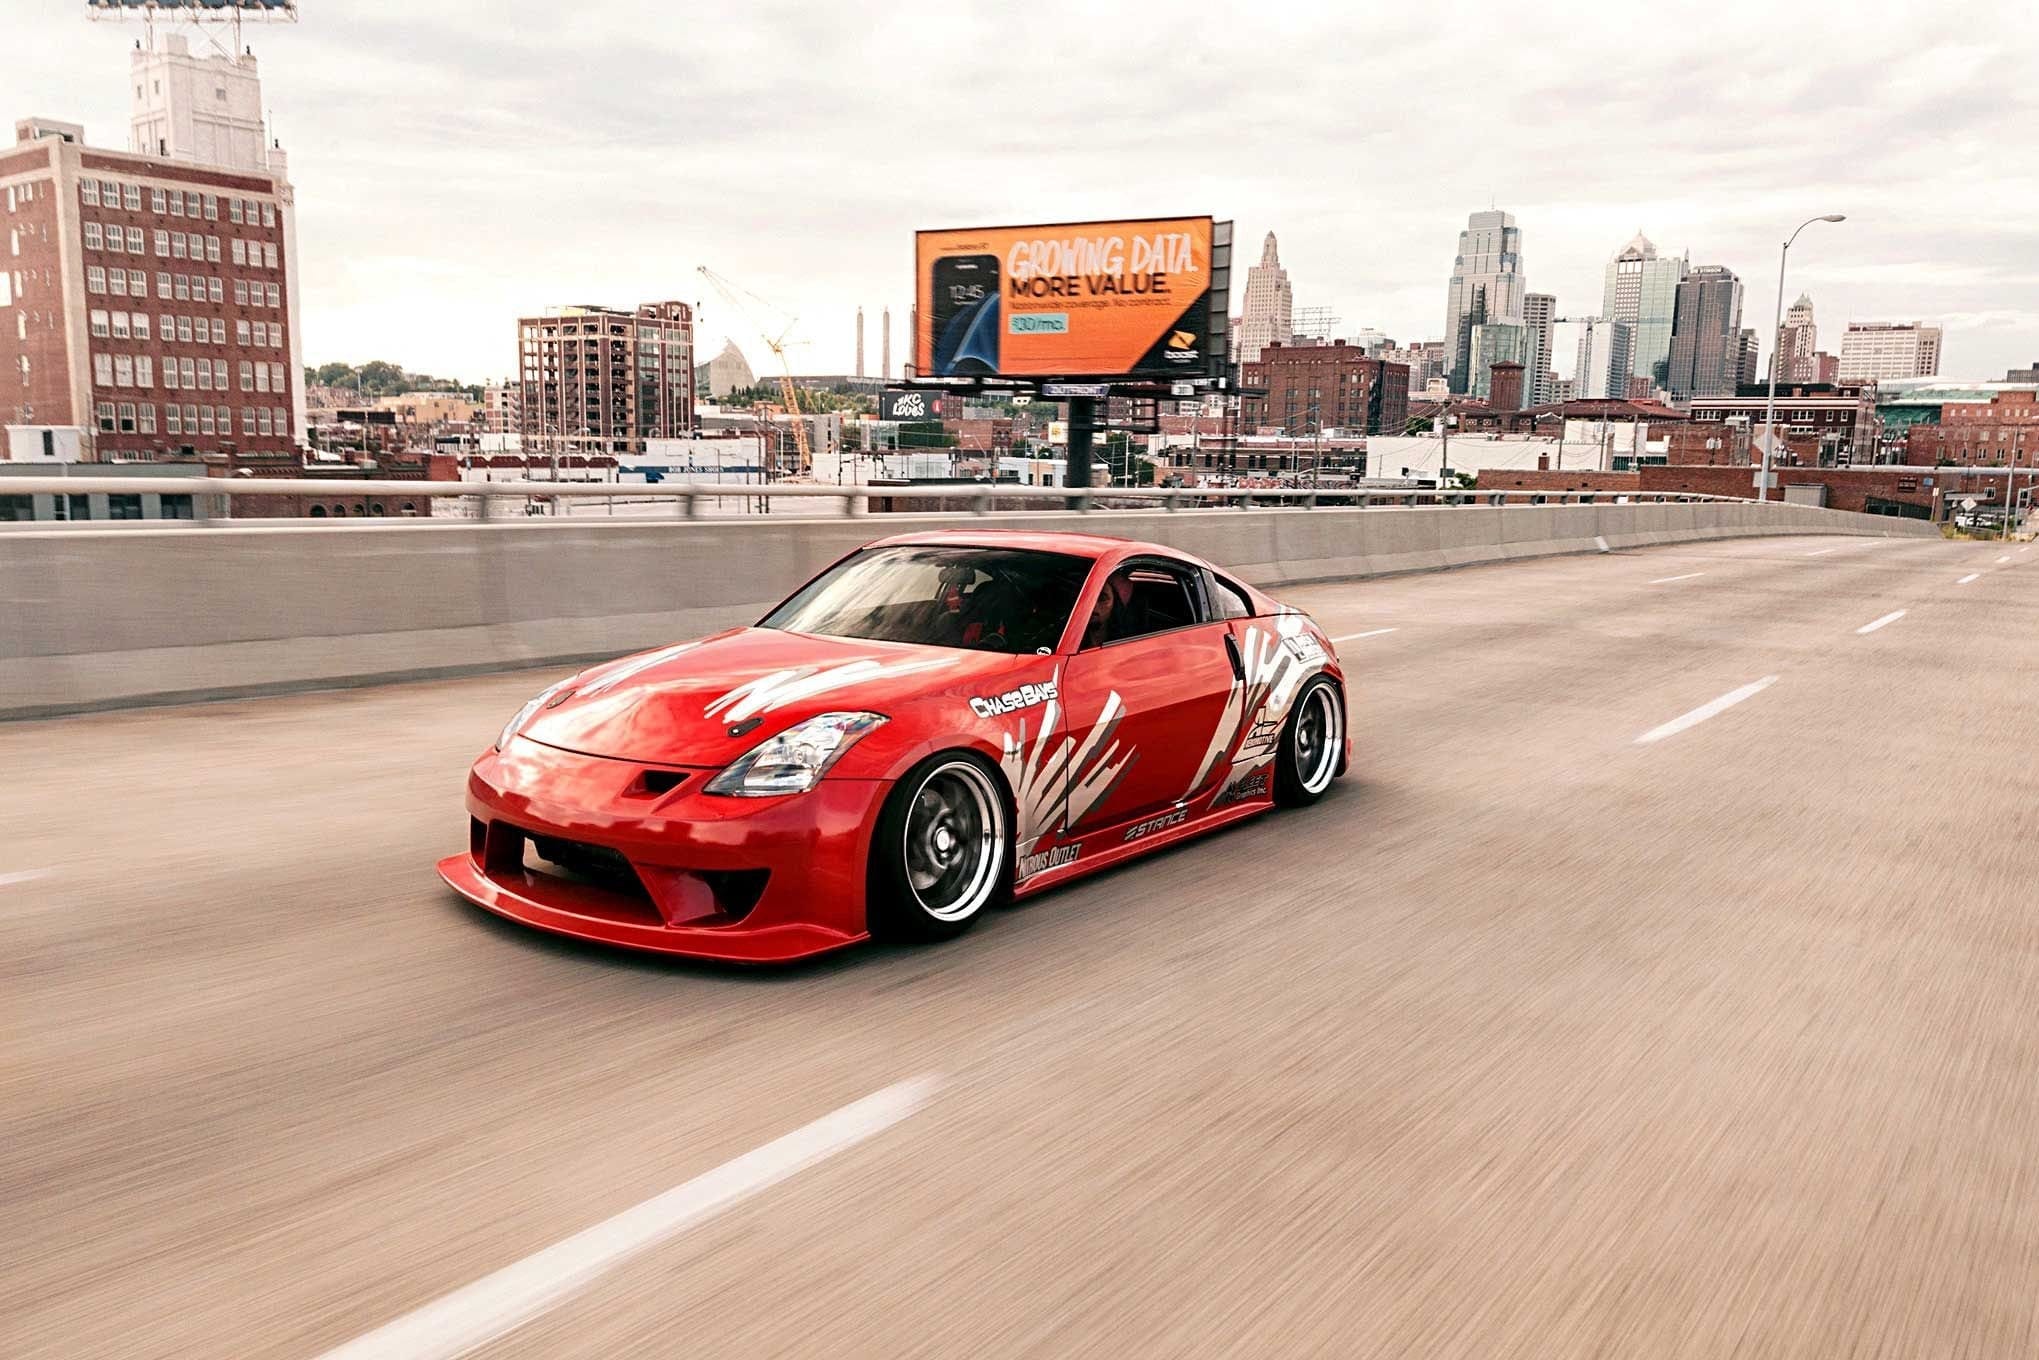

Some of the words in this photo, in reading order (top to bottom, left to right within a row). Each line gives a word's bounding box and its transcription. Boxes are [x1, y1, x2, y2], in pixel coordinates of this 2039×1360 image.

[1007, 237, 1125, 282] GROWING
[1010, 275, 1080, 298] MORE
[1085, 271, 1172, 296] VALUE.
[1136, 809, 1188, 837] STANCE
[1018, 851, 1049, 879] NITROUS
[1048, 843, 1082, 866] OUTLET
